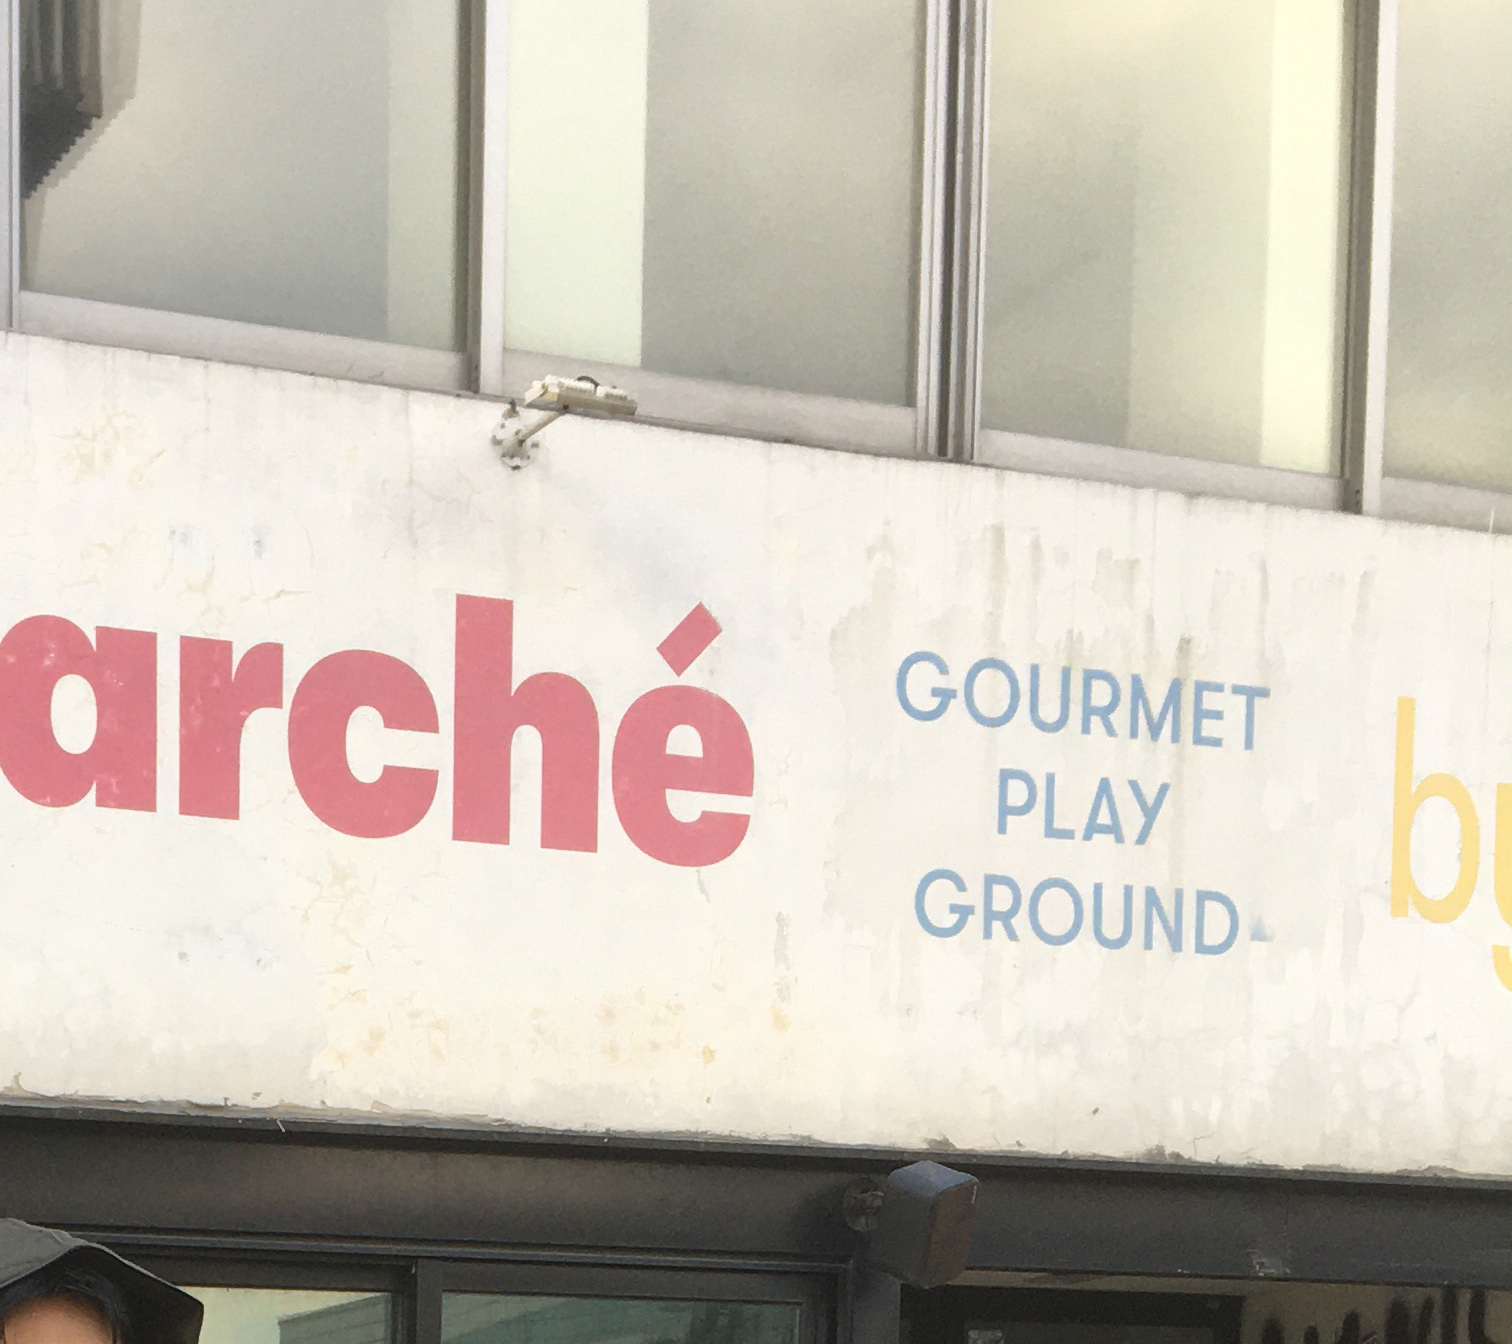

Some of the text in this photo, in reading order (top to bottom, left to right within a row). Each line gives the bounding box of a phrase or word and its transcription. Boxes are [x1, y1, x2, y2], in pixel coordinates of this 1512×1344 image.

[894, 650, 1271, 751] GOURMET
[996, 767, 1171, 846] PLAY
[1390, 695, 1512, 993] b
[914, 868, 1241, 957] GROUND
